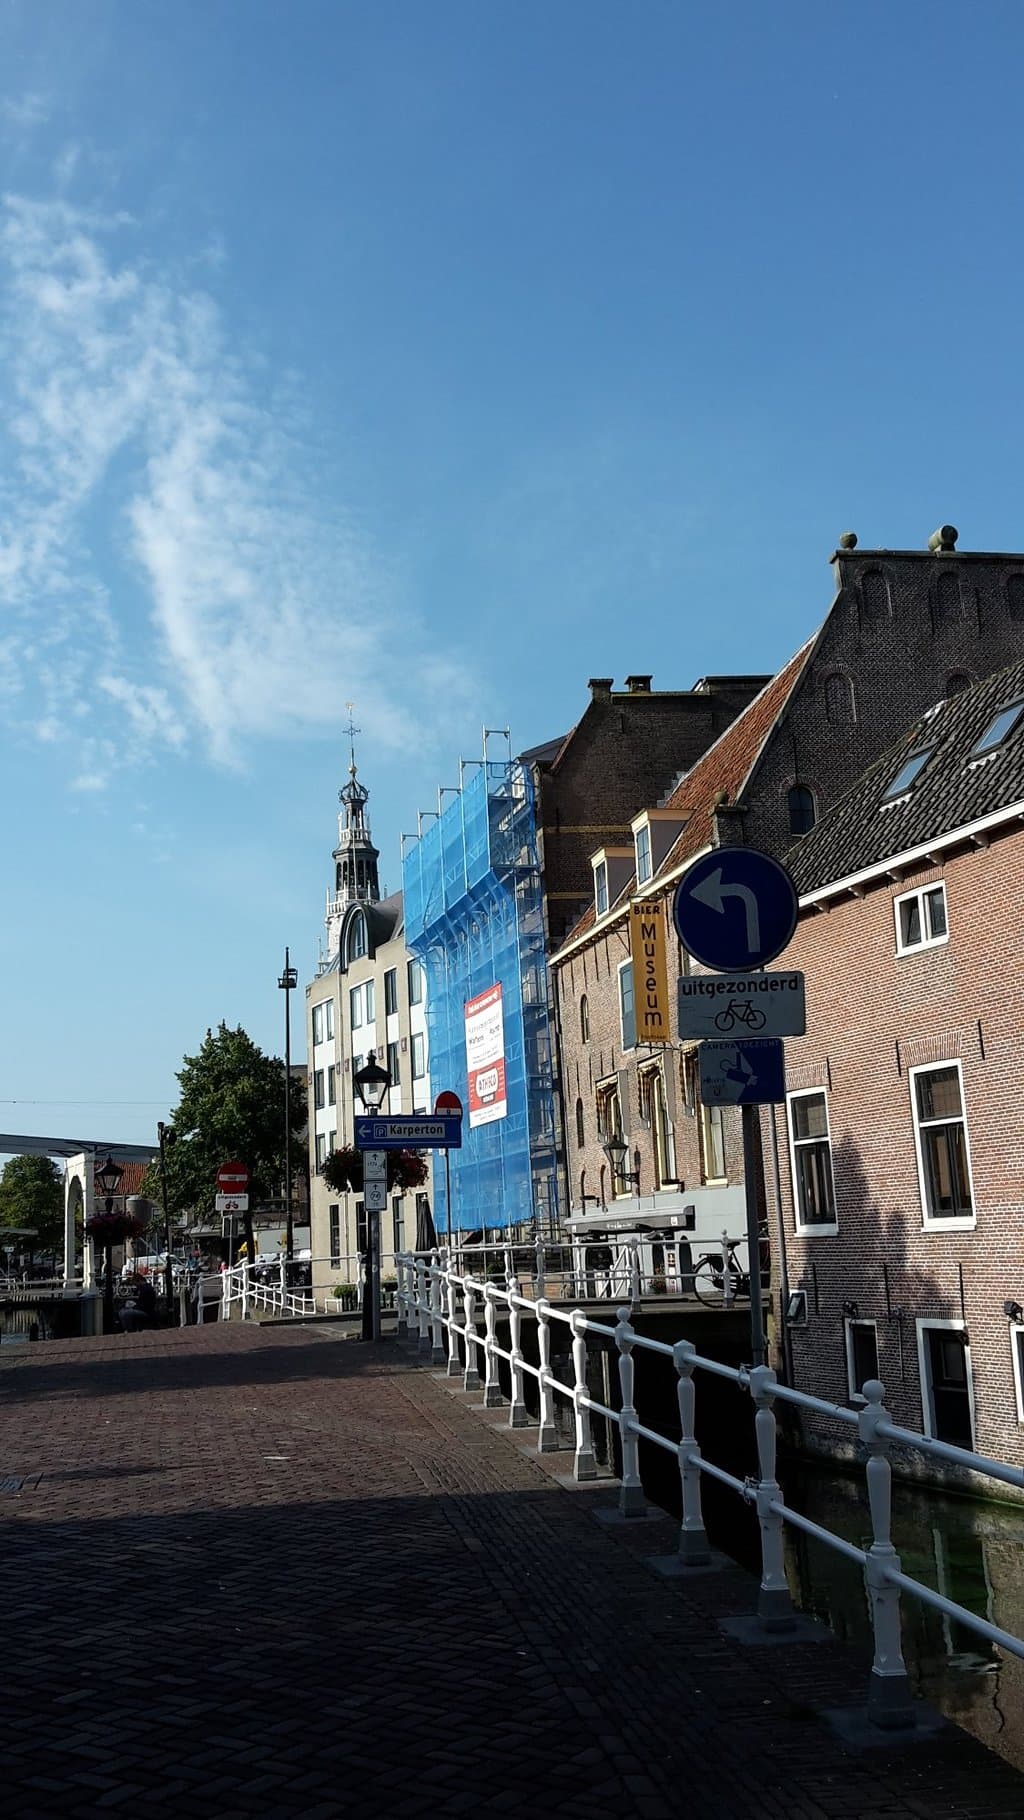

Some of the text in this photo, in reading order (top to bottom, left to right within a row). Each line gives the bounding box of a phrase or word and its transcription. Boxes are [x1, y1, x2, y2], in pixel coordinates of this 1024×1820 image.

[633, 905, 661, 915] BIER
[641, 922, 662, 1026] Museum
[682, 975, 798, 999] uitgezonderd
[390, 1124, 443, 1136] Karperton
